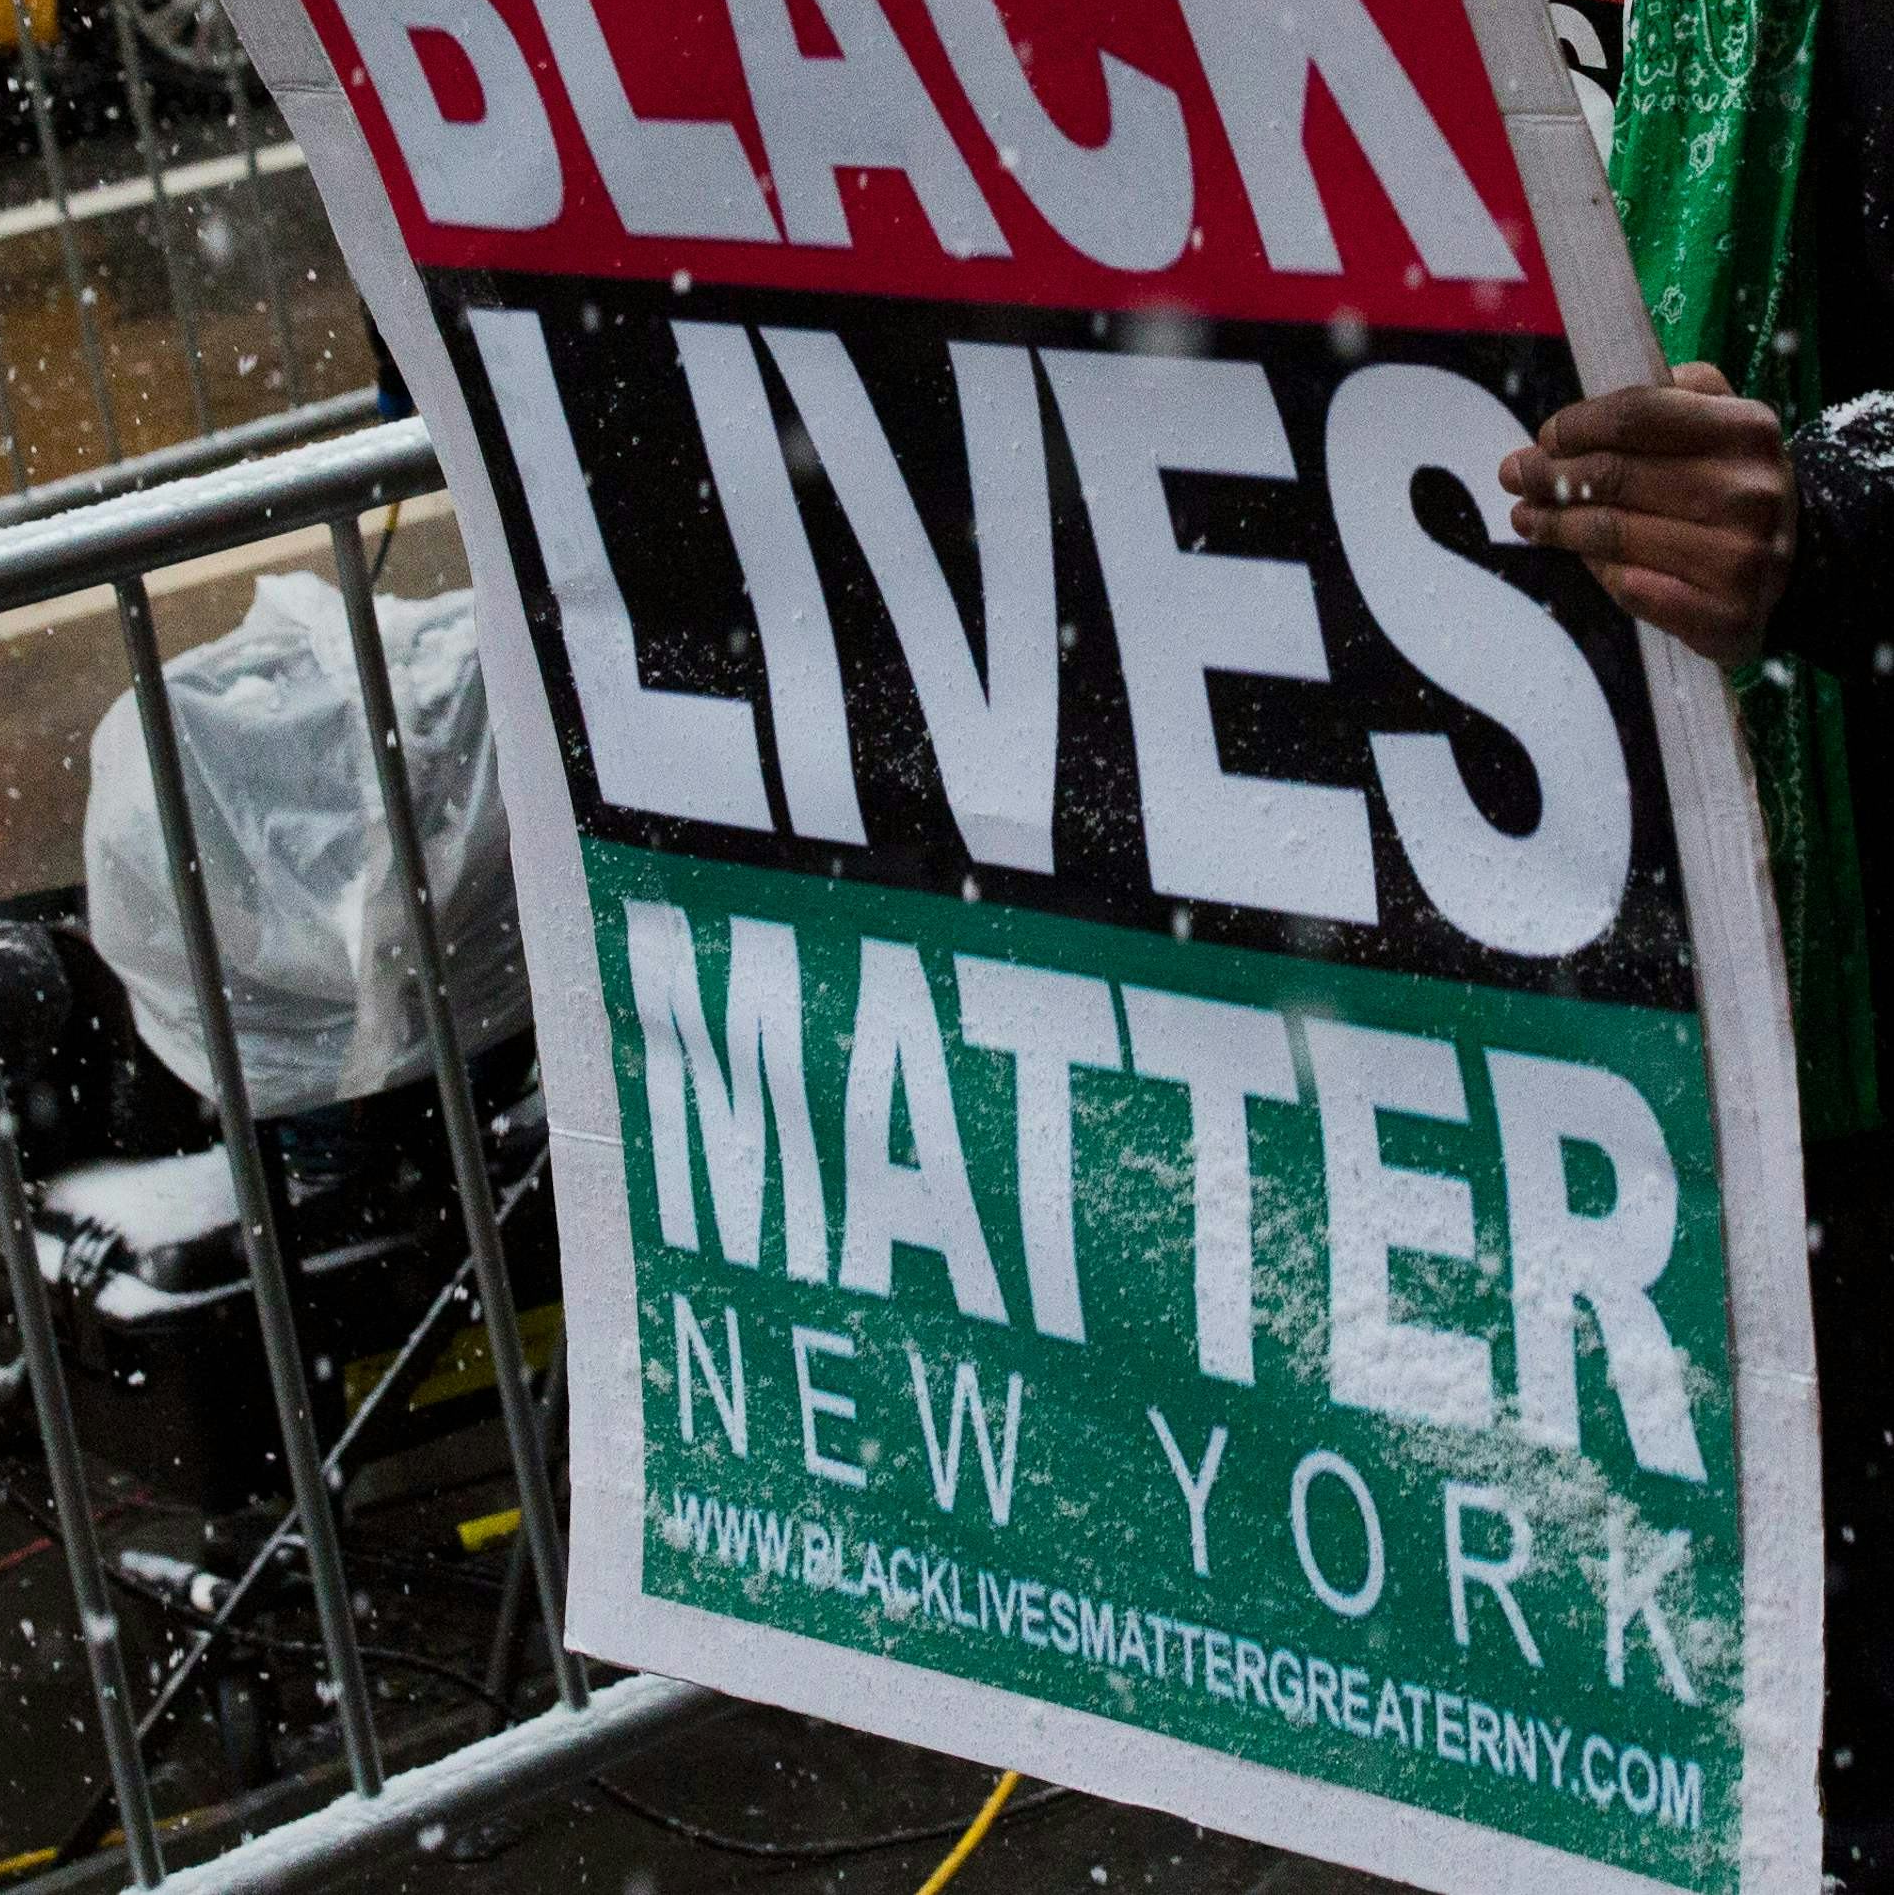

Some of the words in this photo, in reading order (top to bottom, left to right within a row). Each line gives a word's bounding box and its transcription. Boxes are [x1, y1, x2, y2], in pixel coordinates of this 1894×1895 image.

[467, 307, 1635, 958] LIVES
[625, 900, 1707, 1484] MATTER
[672, 1491, 1703, 1830] WWW.BLACKLIVESMATTERGREATERNY.COM
[674, 1293, 1025, 1526] NEW
[1147, 1406, 1697, 1707] YORK
